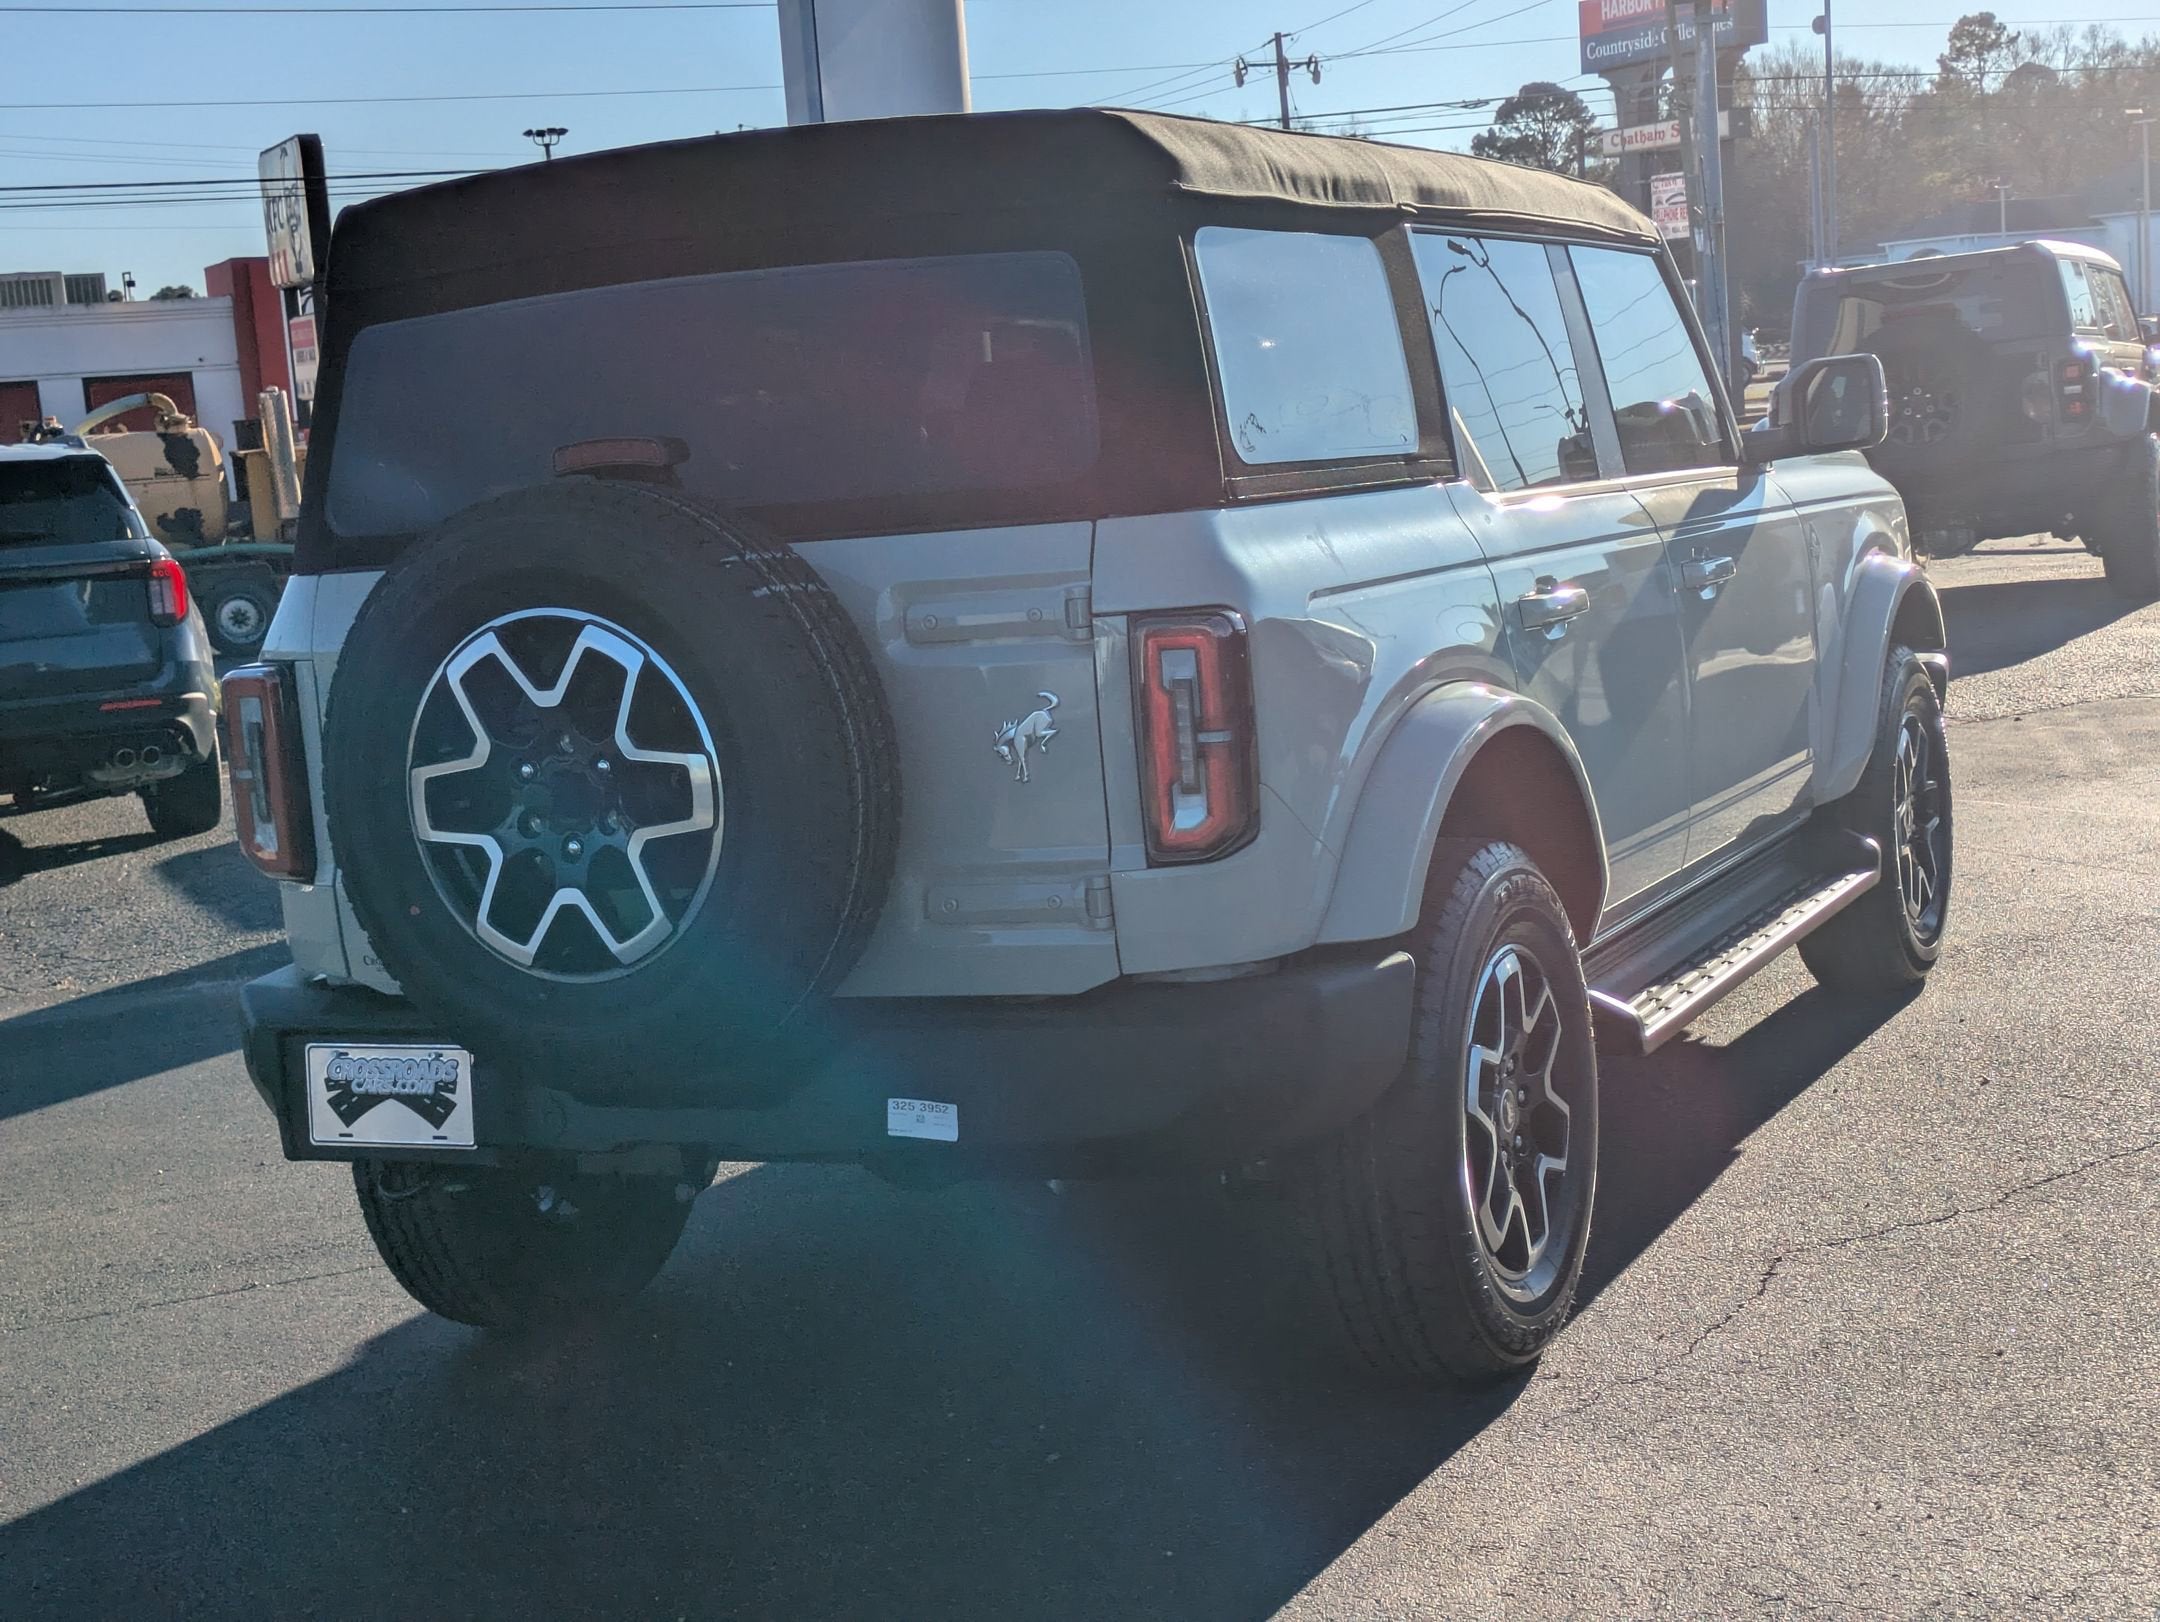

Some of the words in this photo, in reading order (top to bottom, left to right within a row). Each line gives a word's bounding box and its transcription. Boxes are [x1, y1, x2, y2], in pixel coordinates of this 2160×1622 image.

[1601, 0, 1653, 20] HARBOR
[1586, 28, 1659, 60] Countryside
[1610, 129, 1665, 148] Chatham
[1671, 123, 1680, 138] S
[264, 196, 285, 235] KFC
[327, 1057, 459, 1083] CROSSROADS
[351, 1079, 435, 1095] CARS.COM
[893, 1101, 915, 1111] 325
[920, 1103, 948, 1114] 3952
